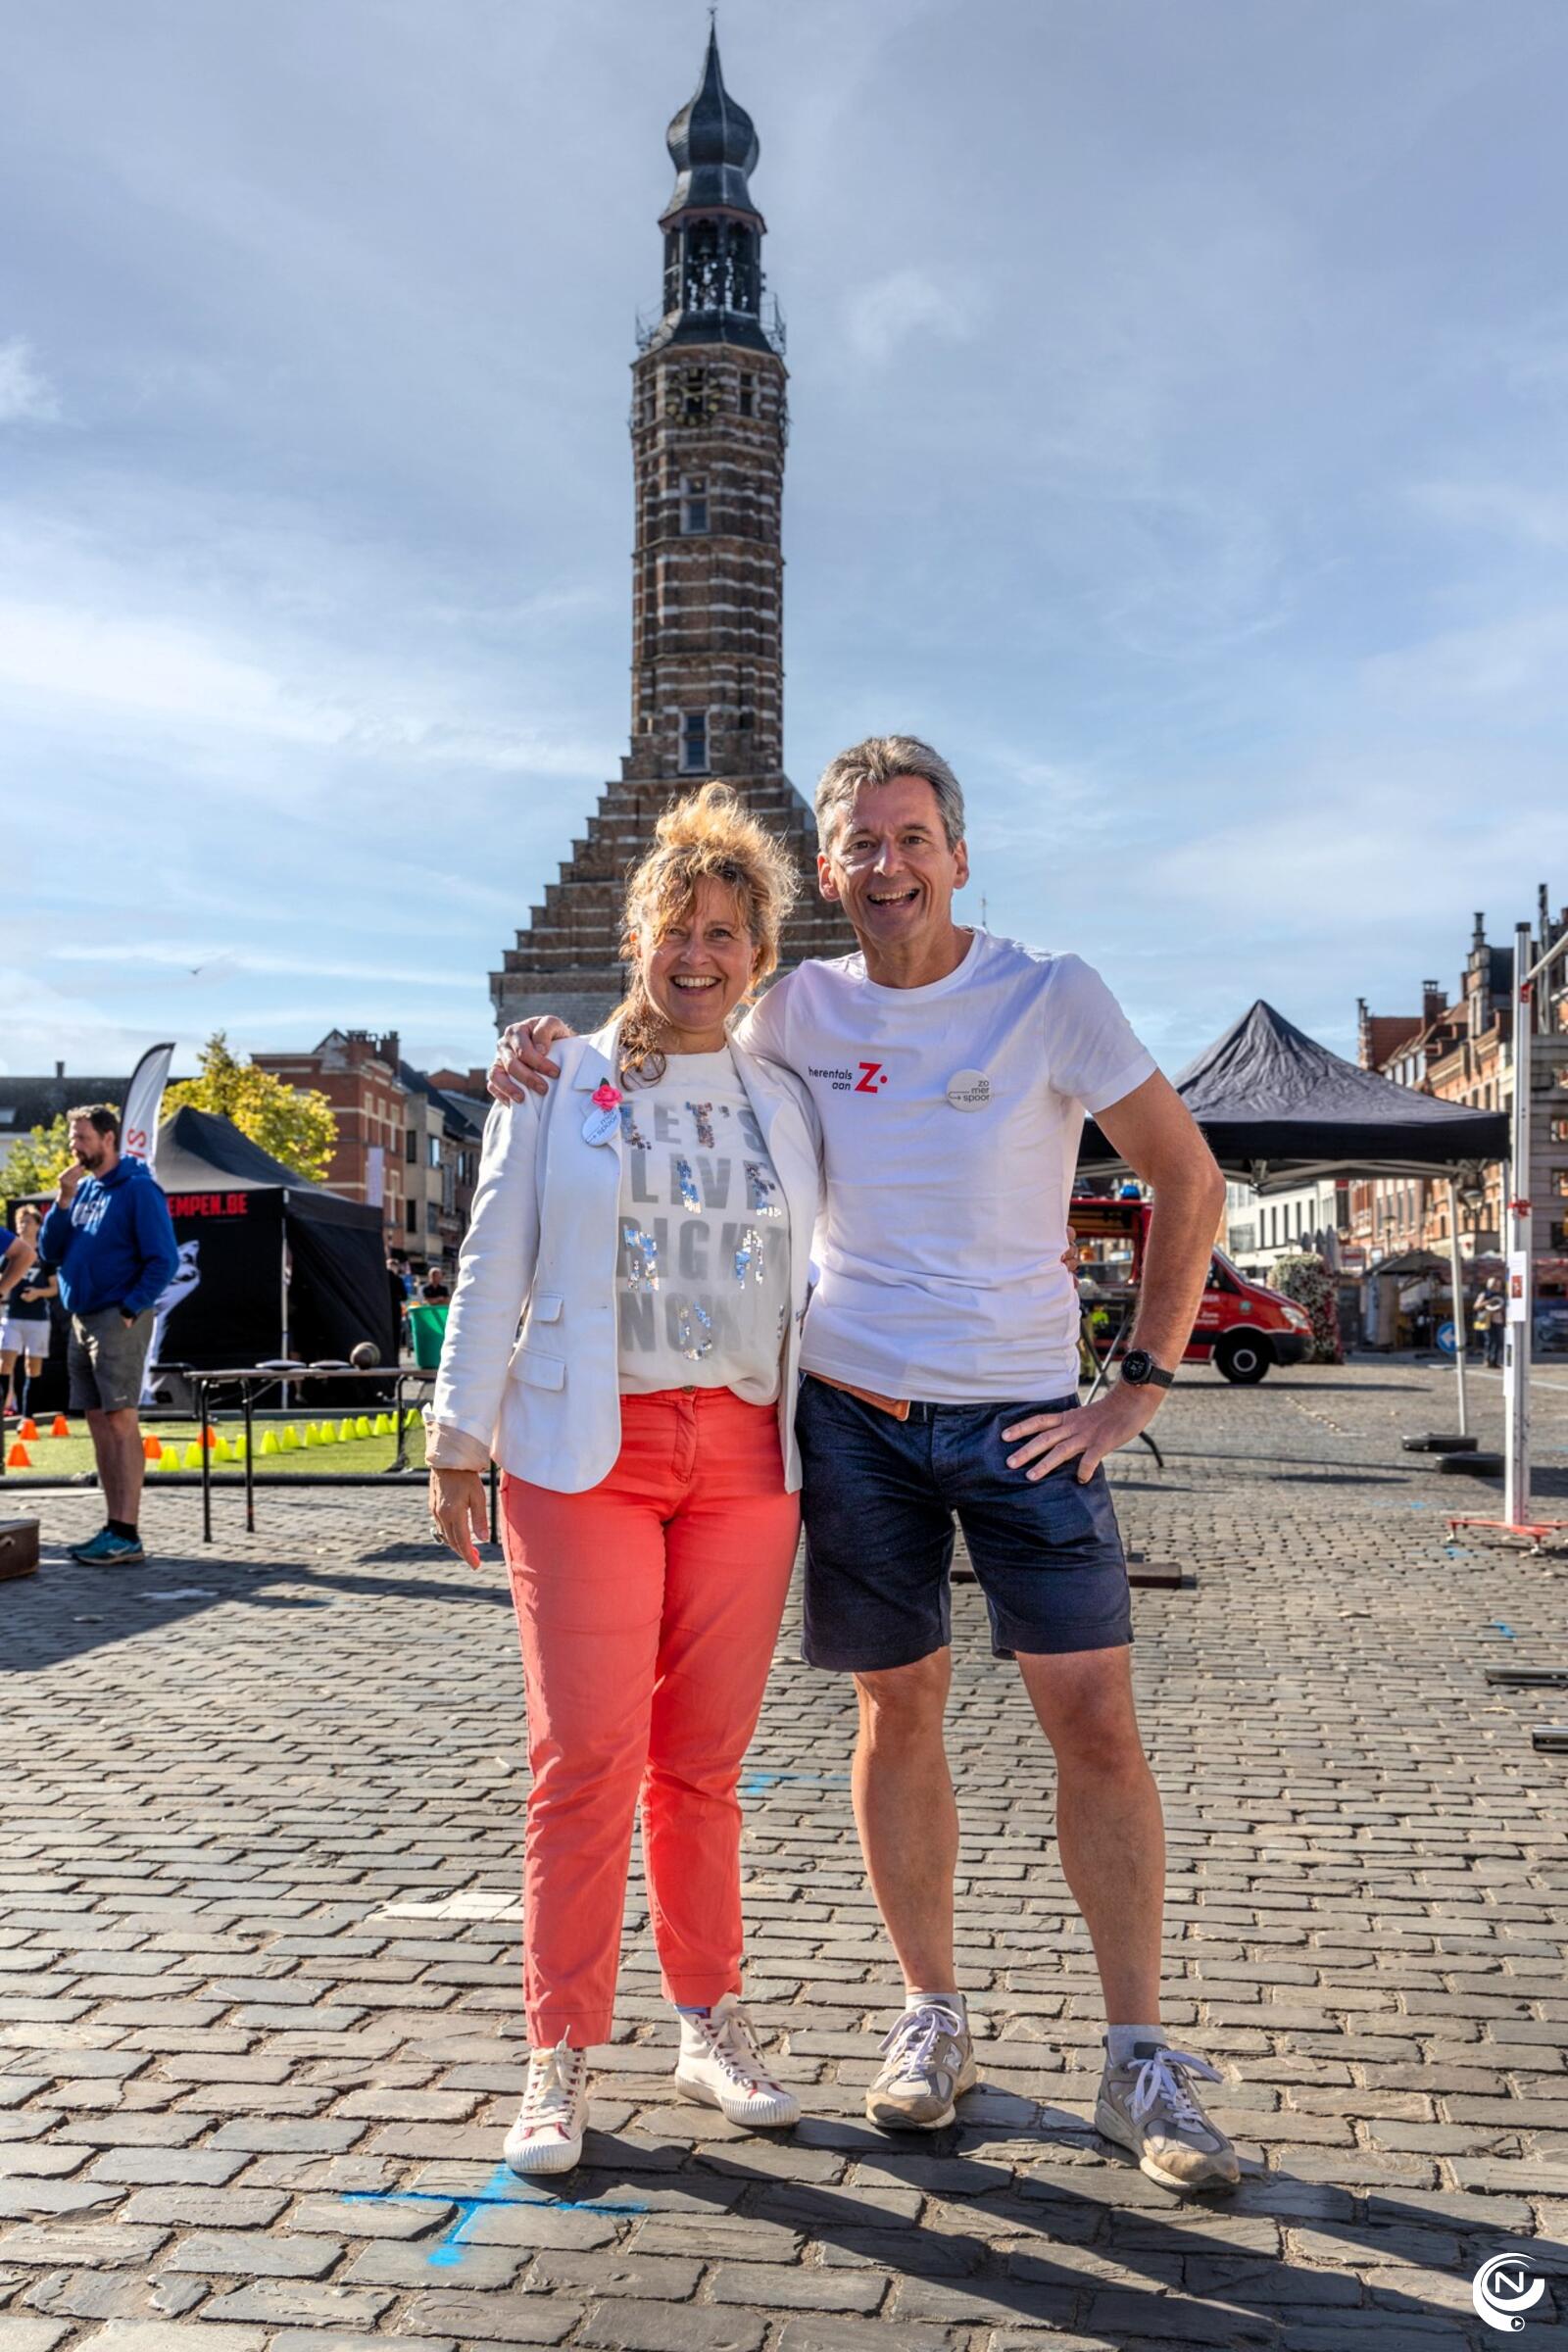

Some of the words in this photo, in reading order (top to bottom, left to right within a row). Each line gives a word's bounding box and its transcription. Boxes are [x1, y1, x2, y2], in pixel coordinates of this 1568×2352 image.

[831, 1081, 852, 1091] aan
[962, 1094, 990, 1103] spoor
[630, 1150, 783, 1214] LIVE
